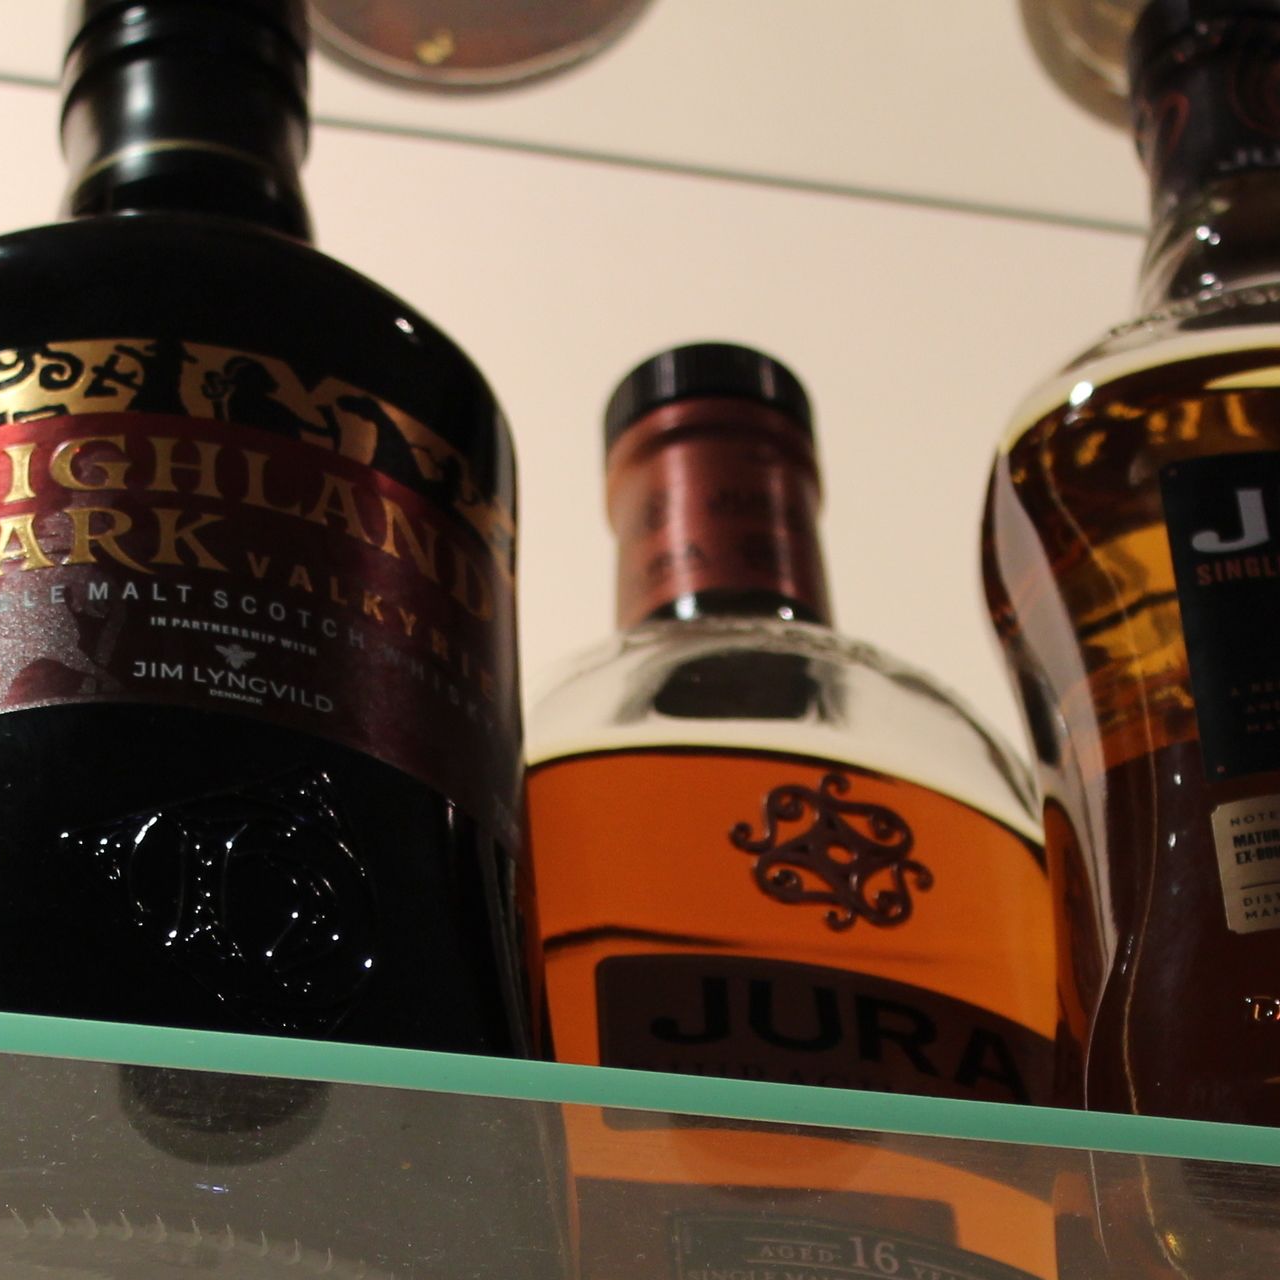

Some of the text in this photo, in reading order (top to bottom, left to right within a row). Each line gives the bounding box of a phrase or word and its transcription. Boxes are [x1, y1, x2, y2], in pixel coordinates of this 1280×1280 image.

[88, 580, 192, 604] MALT
[212, 588, 366, 650] SCOTCH
[149, 615, 318, 657] IN PARTNERSHIP WITH
[246, 551, 494, 698] VALKYRIE
[132, 660, 335, 714] JIM LYNGVILD
[208, 687, 263, 707] DENMARK
[650, 976, 1032, 1105] JURA
[759, 1243, 835, 1264] AGED
[848, 1235, 900, 1276] 16
